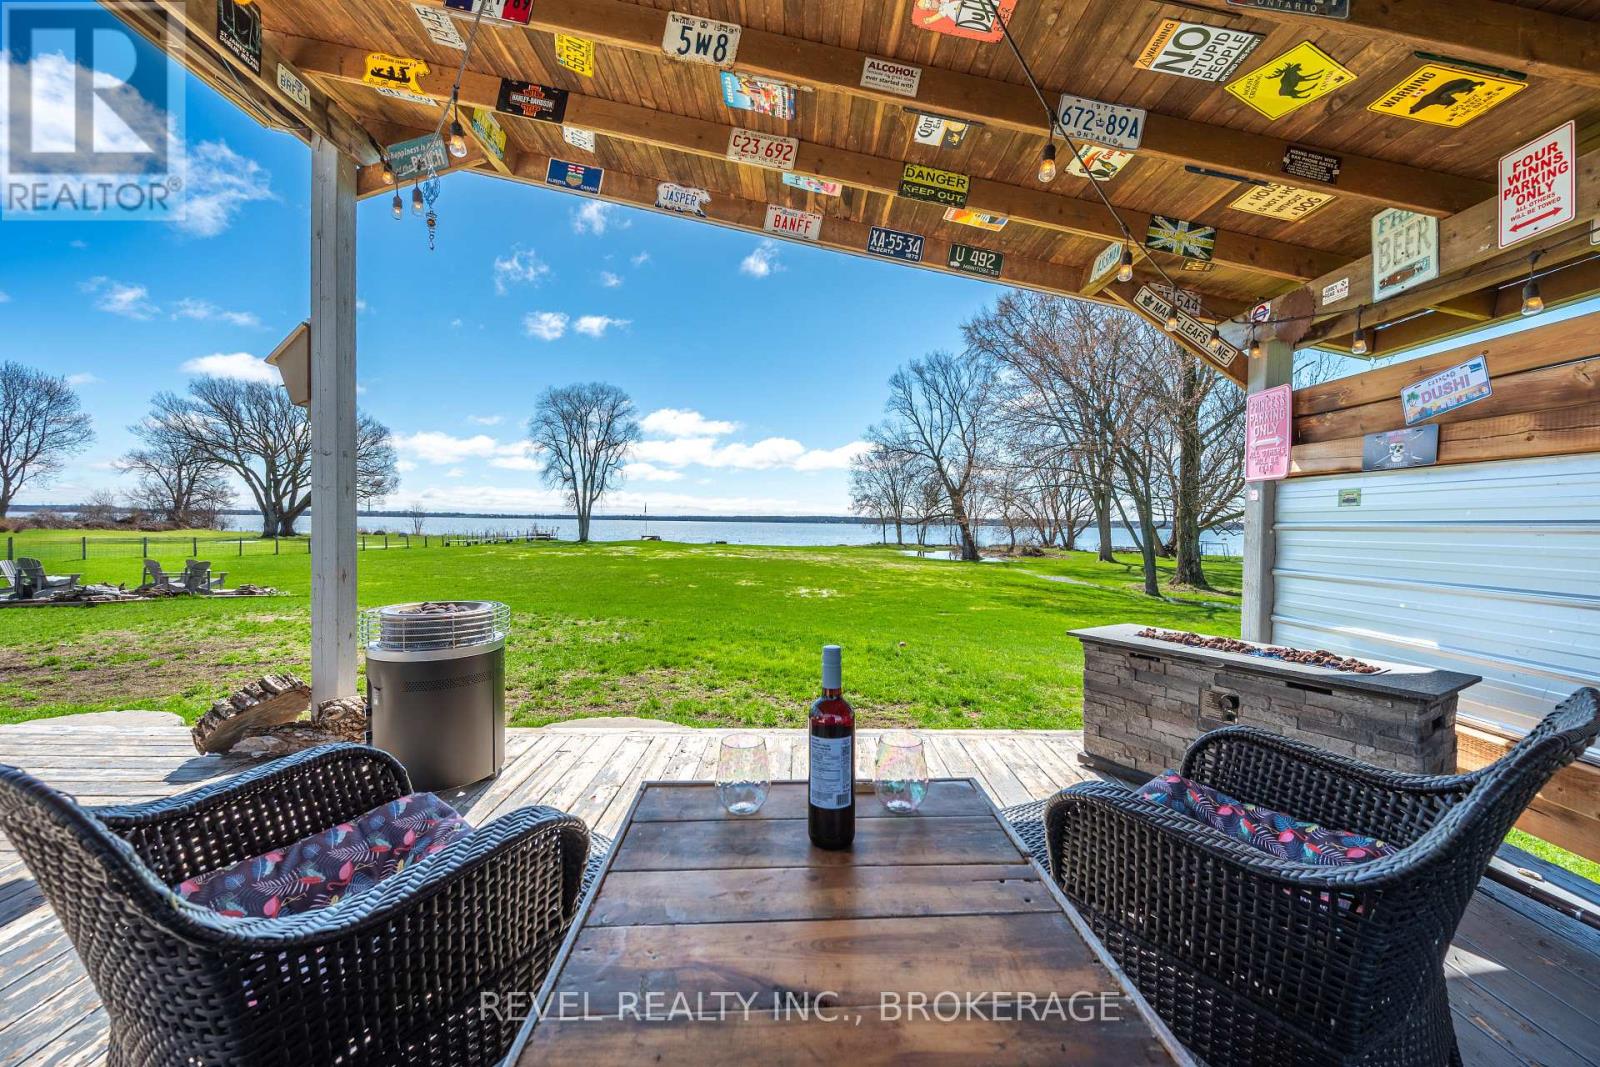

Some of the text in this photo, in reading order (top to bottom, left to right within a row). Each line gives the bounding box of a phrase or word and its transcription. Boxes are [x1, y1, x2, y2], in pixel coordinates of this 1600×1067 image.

[677, 26, 728, 62] 5W8
[1146, 23, 1175, 57] WARNING
[1153, 27, 1212, 73] NO
[1187, 32, 1231, 76] STUPID
[1202, 34, 1250, 80] PEOPLE
[879, 78, 900, 87] started
[1380, 72, 1437, 108] WARNING
[511, 93, 555, 109] HARLEY-DAVIDSON
[1091, 103, 1116, 113] 1972
[917, 117, 935, 138] Cor
[1061, 105, 1139, 140] 672 89A
[1076, 131, 1118, 144] ONTARIO
[1512, 141, 1559, 173] FOUR
[905, 166, 966, 189] DANGER
[1507, 151, 1565, 187] WINNS
[902, 183, 935, 196] KEEP
[1503, 160, 1569, 201] PARKING
[663, 189, 697, 206] JASPER
[1250, 183, 1281, 201] HOUS
[1265, 198, 1280, 208] NOT
[1515, 179, 1555, 206] ONLY
[1515, 192, 1556, 214] ALL OTHERS
[1273, 194, 1304, 213] WITHOUT
[1296, 197, 1323, 212] DOG
[1510, 196, 1562, 222] WILL BE TOWED
[774, 214, 813, 233] BANFF
[869, 246, 895, 256] ALBERTA
[1378, 216, 1432, 275] BEER
[955, 247, 996, 270] U 492
[1180, 320, 1209, 345] LEAFS
[1420, 374, 1471, 404] DUSHI
[1250, 393, 1286, 414] PRINCESS
[1249, 407, 1285, 427] PARKING
[1254, 422, 1280, 437] ONLY
